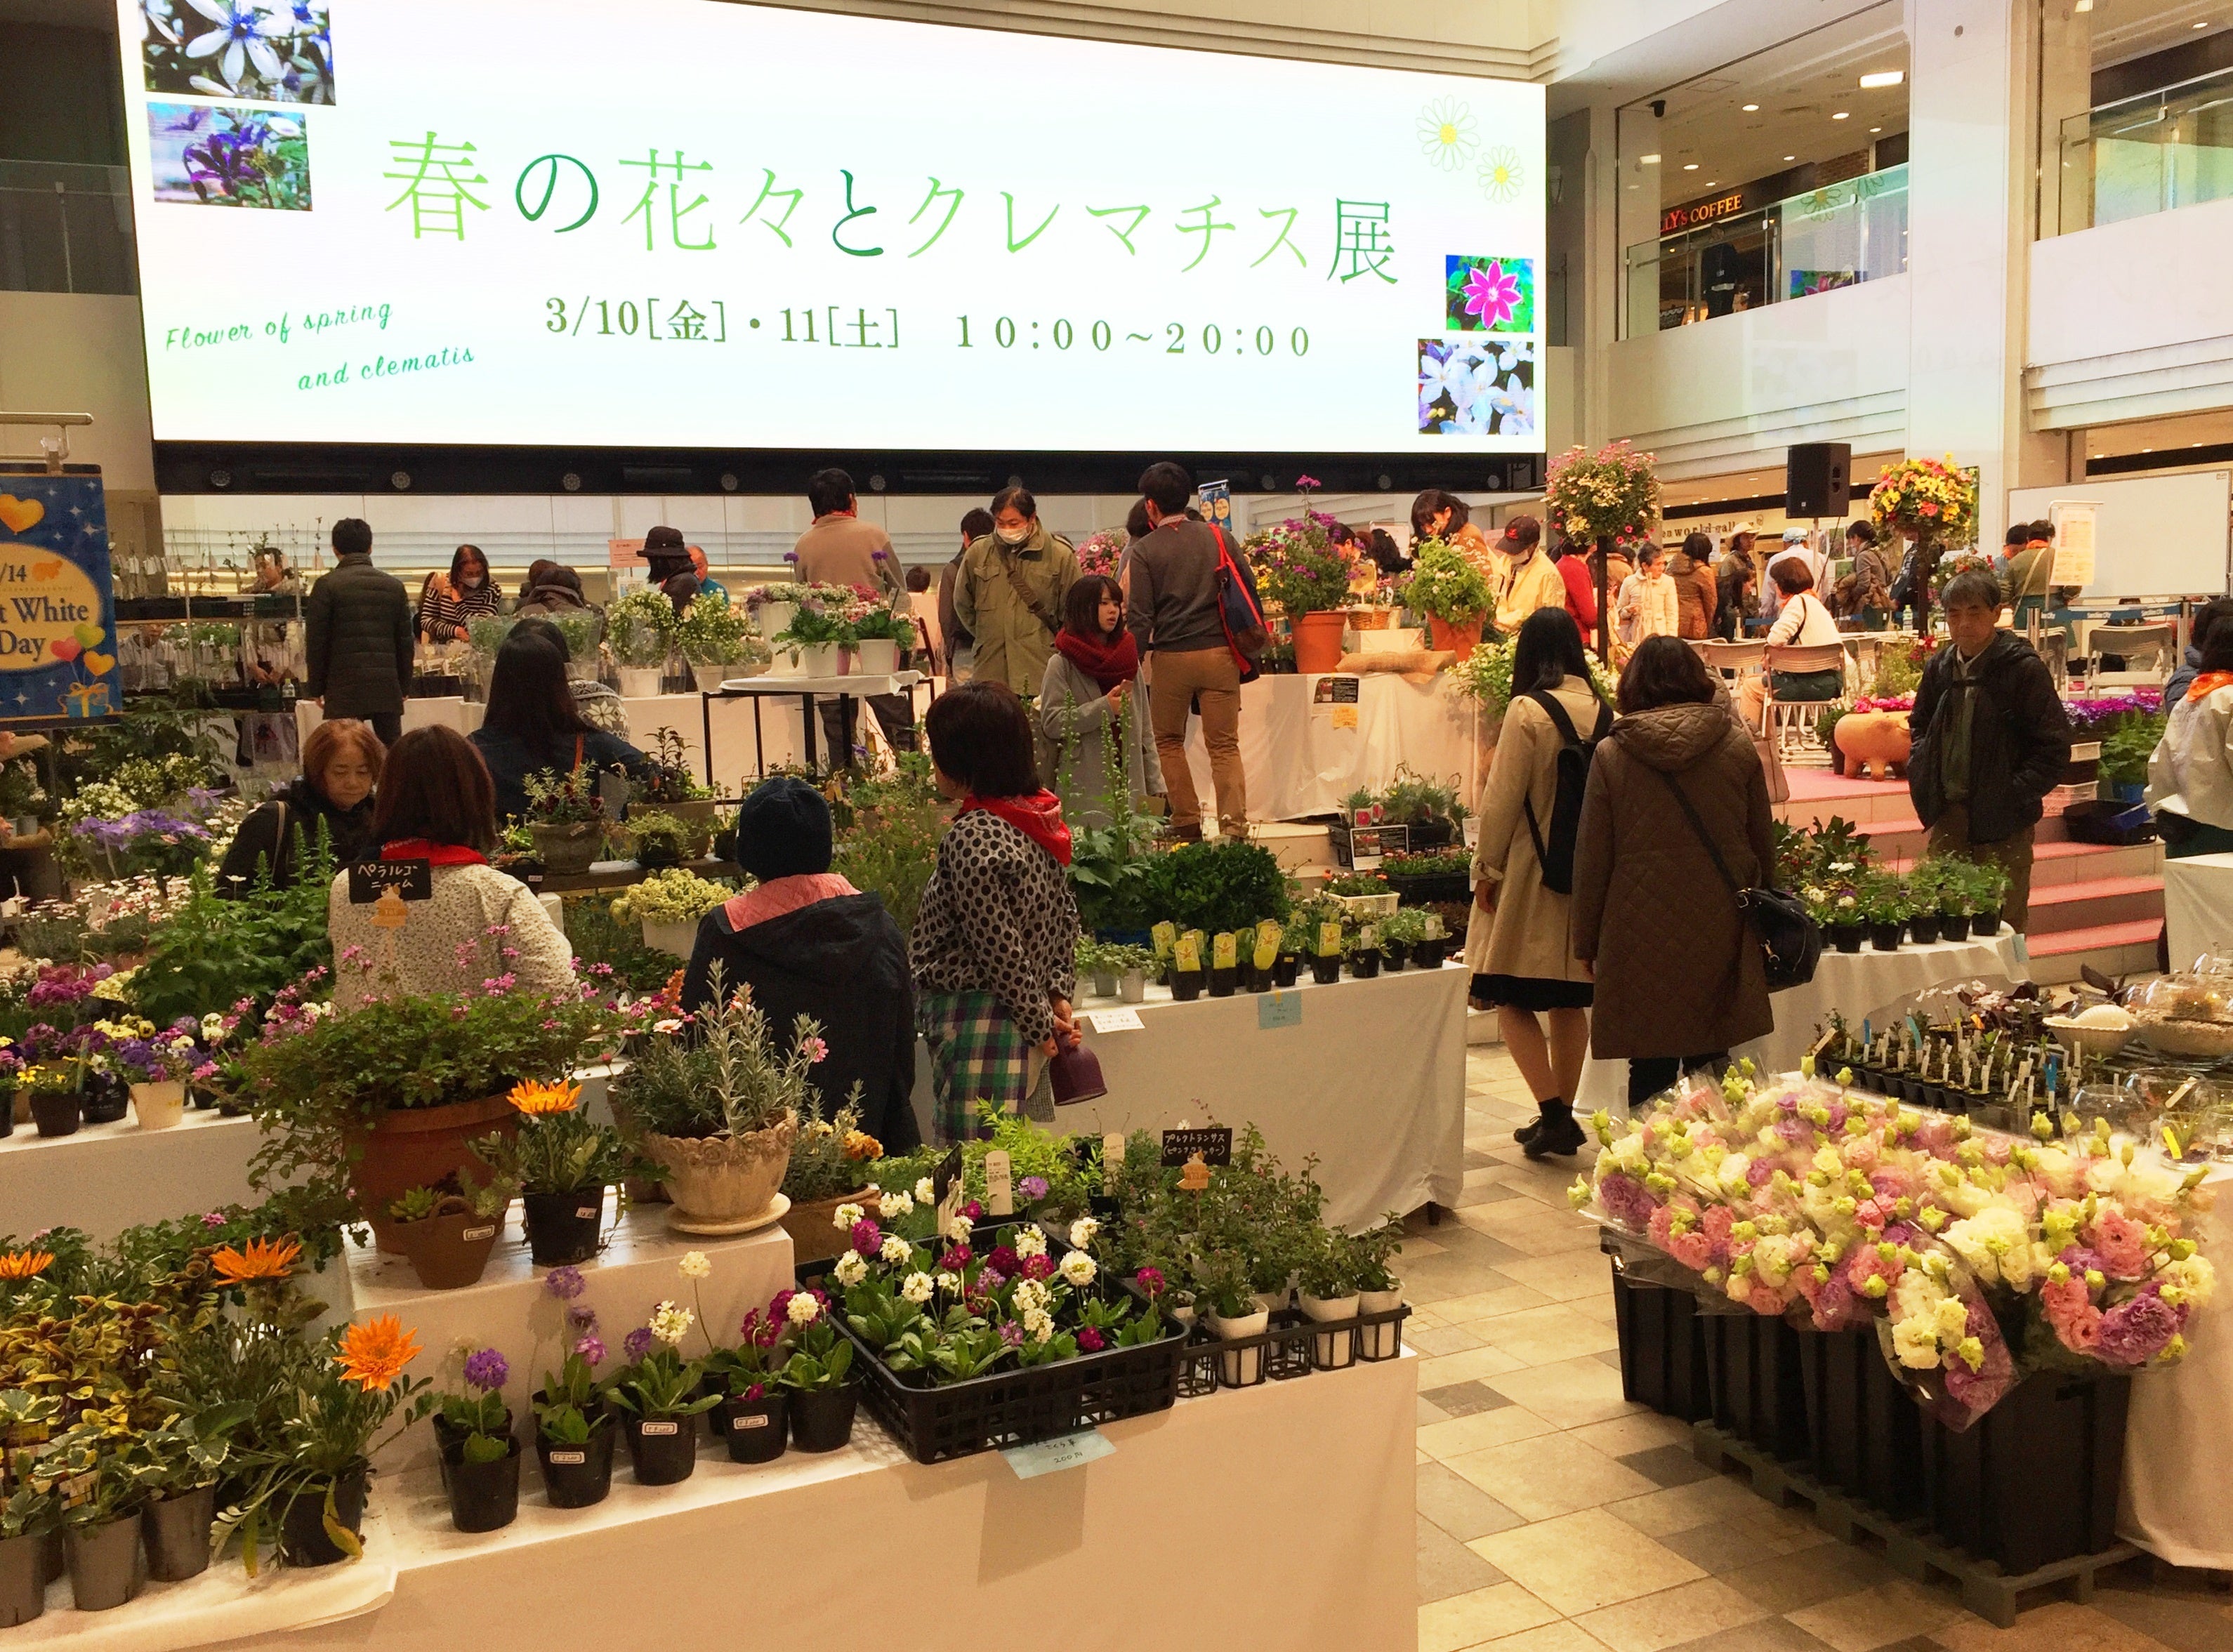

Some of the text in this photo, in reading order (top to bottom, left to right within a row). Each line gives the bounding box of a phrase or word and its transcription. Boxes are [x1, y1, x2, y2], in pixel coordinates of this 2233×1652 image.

[383, 131, 1398, 284] 春の花々とクレマチス展
[1690, 194, 1742, 223] COFFEE
[166, 303, 393, 351] Flower of spring
[298, 347, 475, 390] and clematis
[11, 595, 89, 623] White
[0, 630, 46, 662] Day
[357, 864, 419, 878] ペラルゴ
[1165, 1132, 1225, 1144] プレクトランサス
